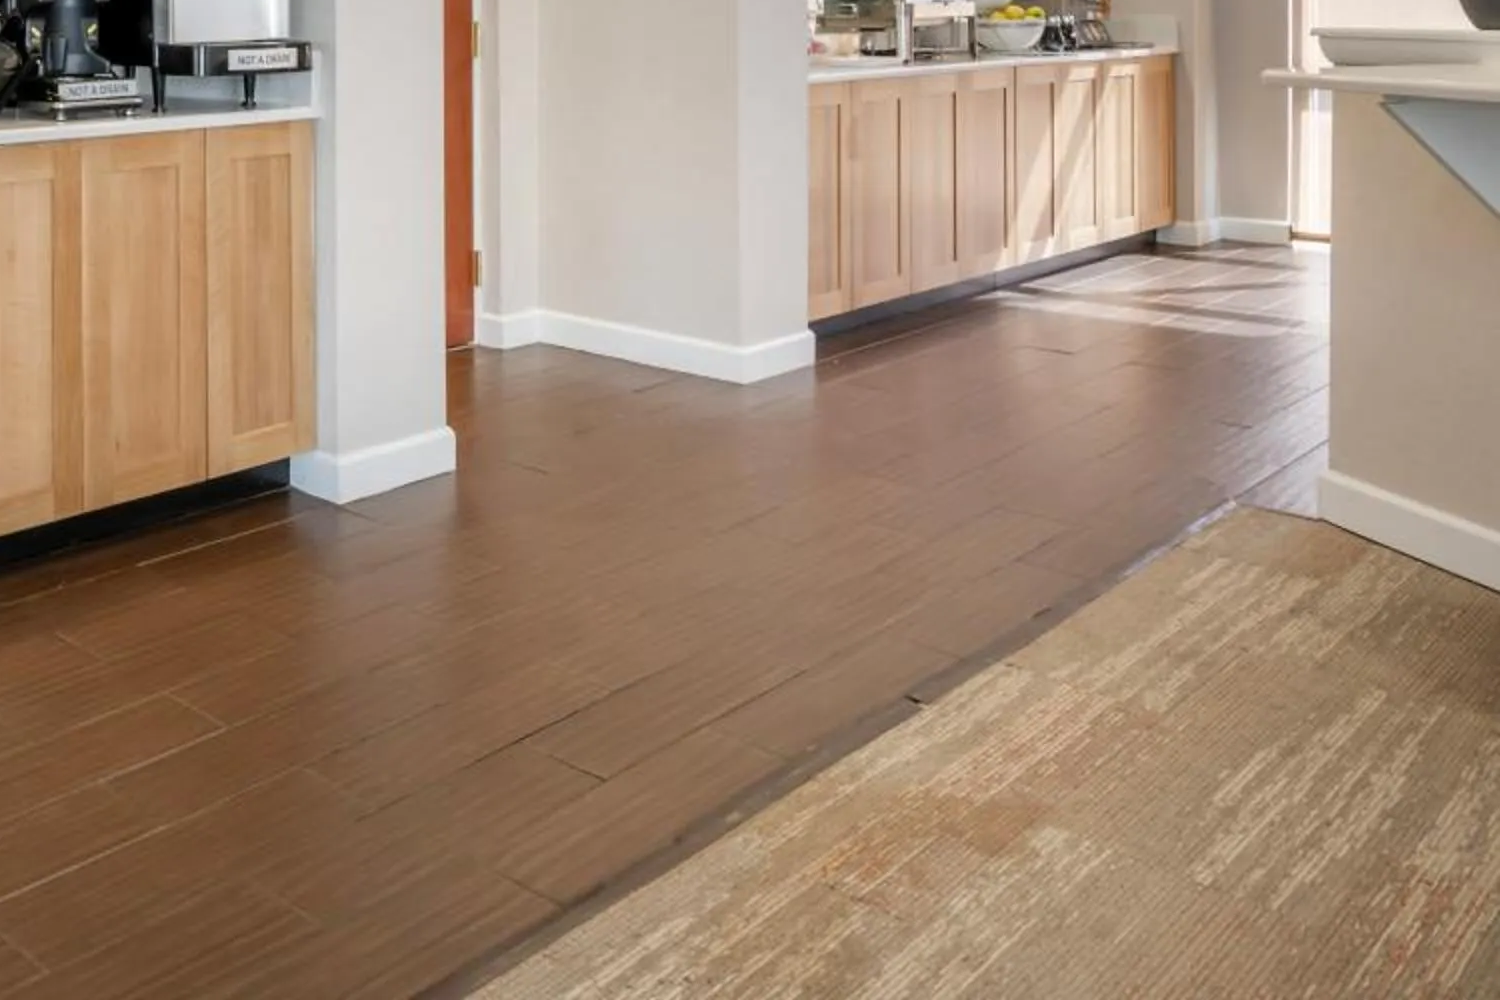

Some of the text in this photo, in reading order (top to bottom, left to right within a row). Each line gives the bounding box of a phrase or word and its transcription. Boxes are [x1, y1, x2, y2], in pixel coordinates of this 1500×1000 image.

[238, 55, 256, 65] NOT
[257, 54, 265, 64] A
[68, 86, 90, 97] NOT
